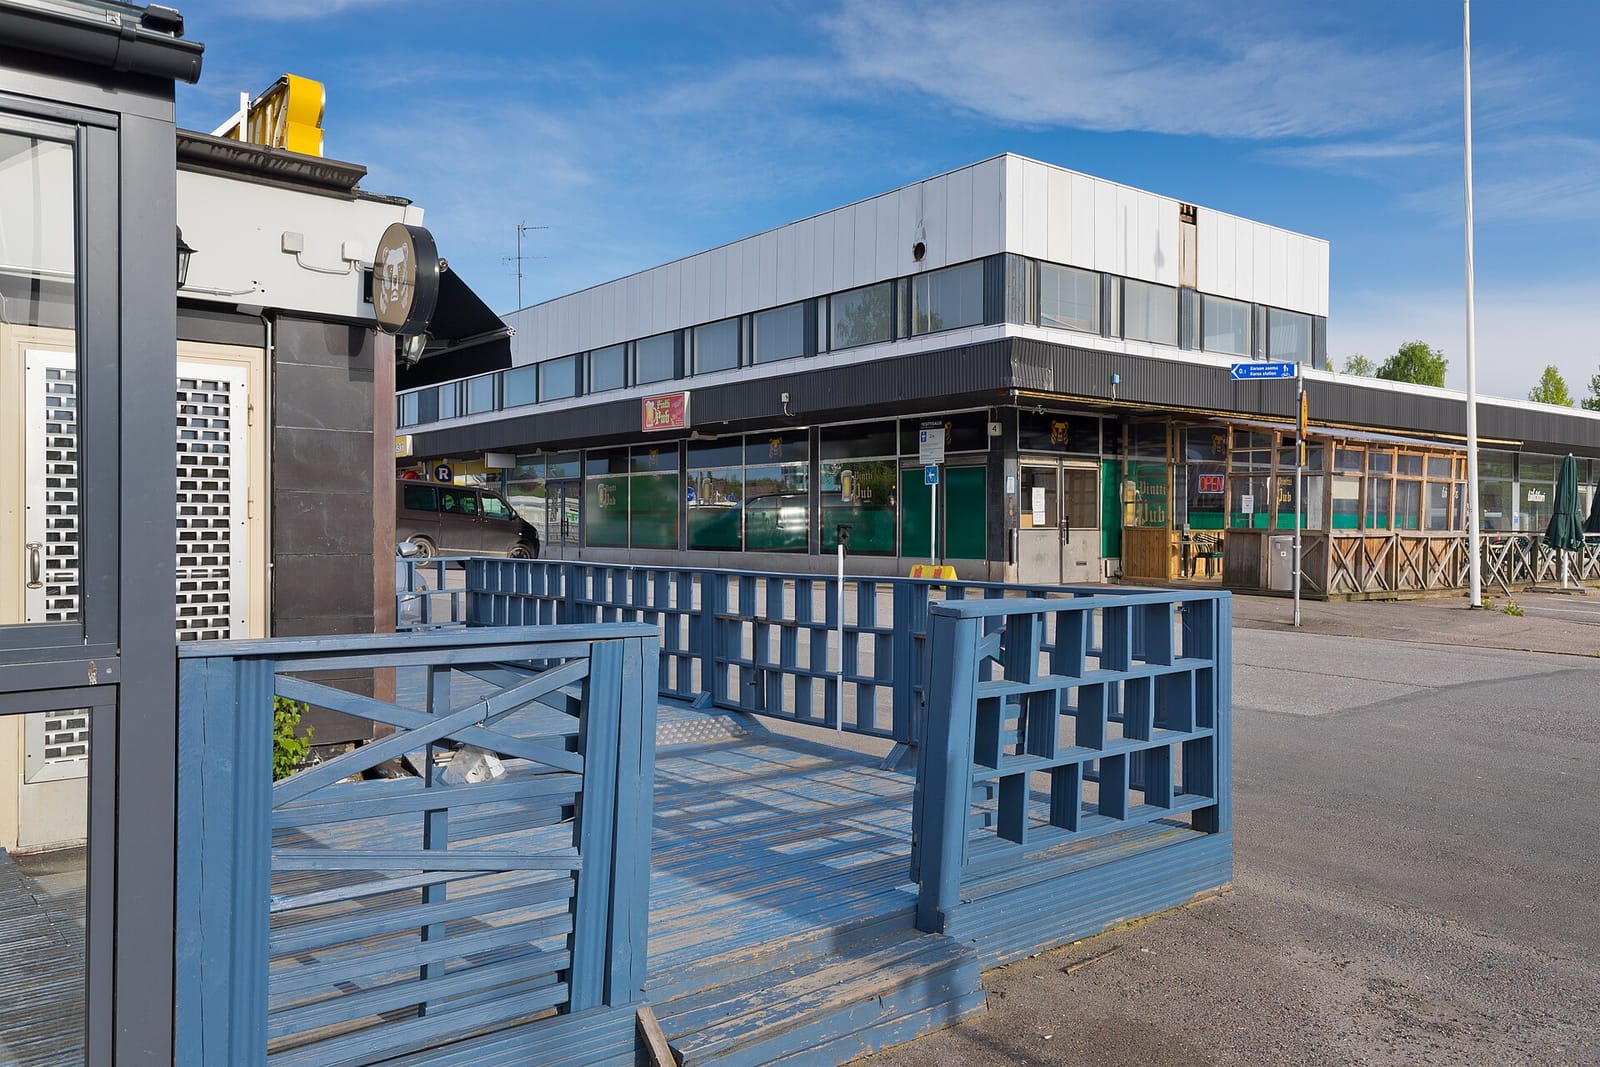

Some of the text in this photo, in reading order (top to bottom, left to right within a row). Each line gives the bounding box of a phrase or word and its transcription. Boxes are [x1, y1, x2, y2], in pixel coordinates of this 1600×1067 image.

[438, 467, 449, 480] R
[1200, 477, 1223, 491] OPEN
[852, 482, 872, 502] Pub
